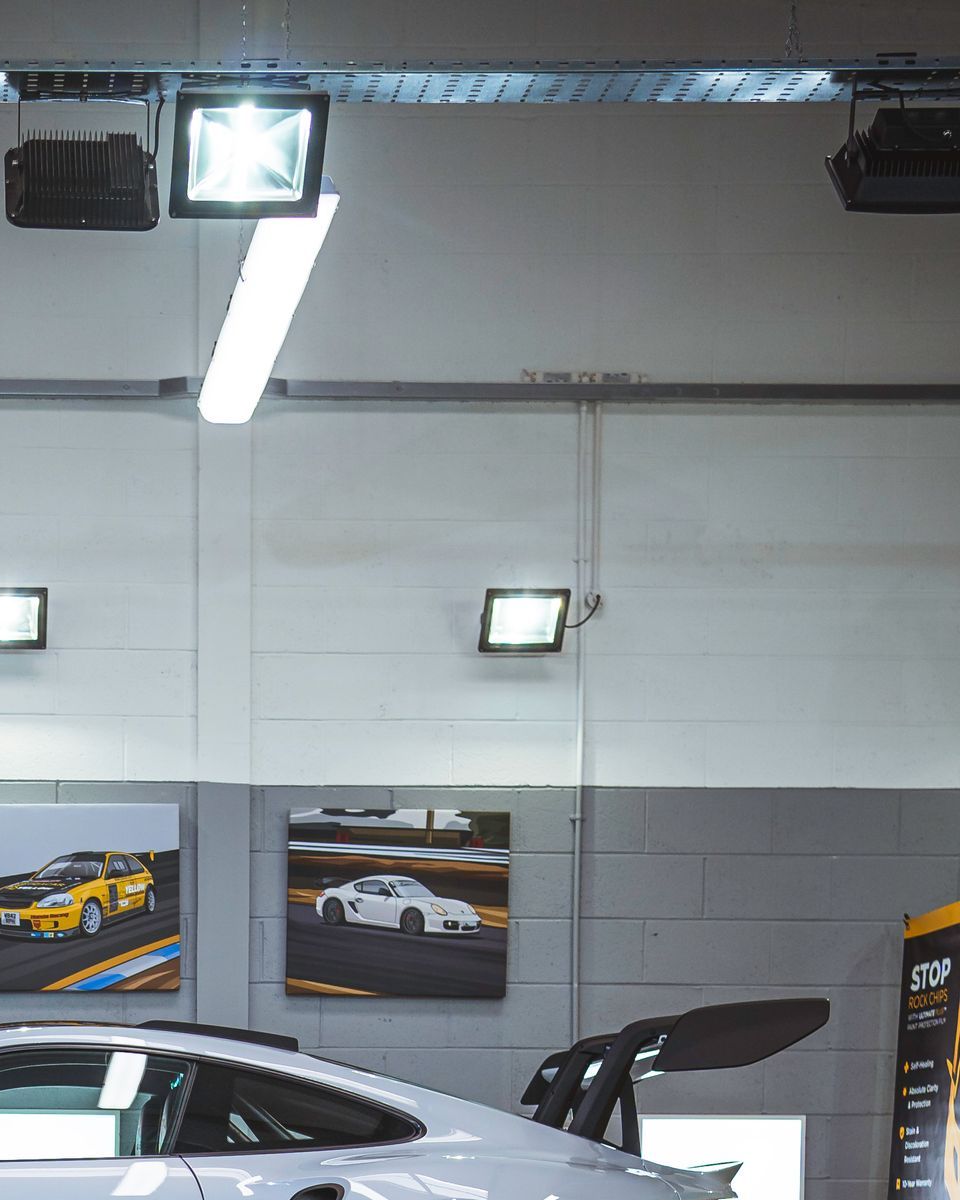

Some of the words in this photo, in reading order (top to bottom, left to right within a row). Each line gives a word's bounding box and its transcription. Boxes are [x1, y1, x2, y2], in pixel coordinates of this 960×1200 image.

[910, 957, 951, 992] STOP
[909, 994, 928, 1009] ROCK
[929, 989, 948, 1005] CHIPS
[909, 1087, 926, 1095] Absolute
[911, 1100, 931, 1108] Protection
